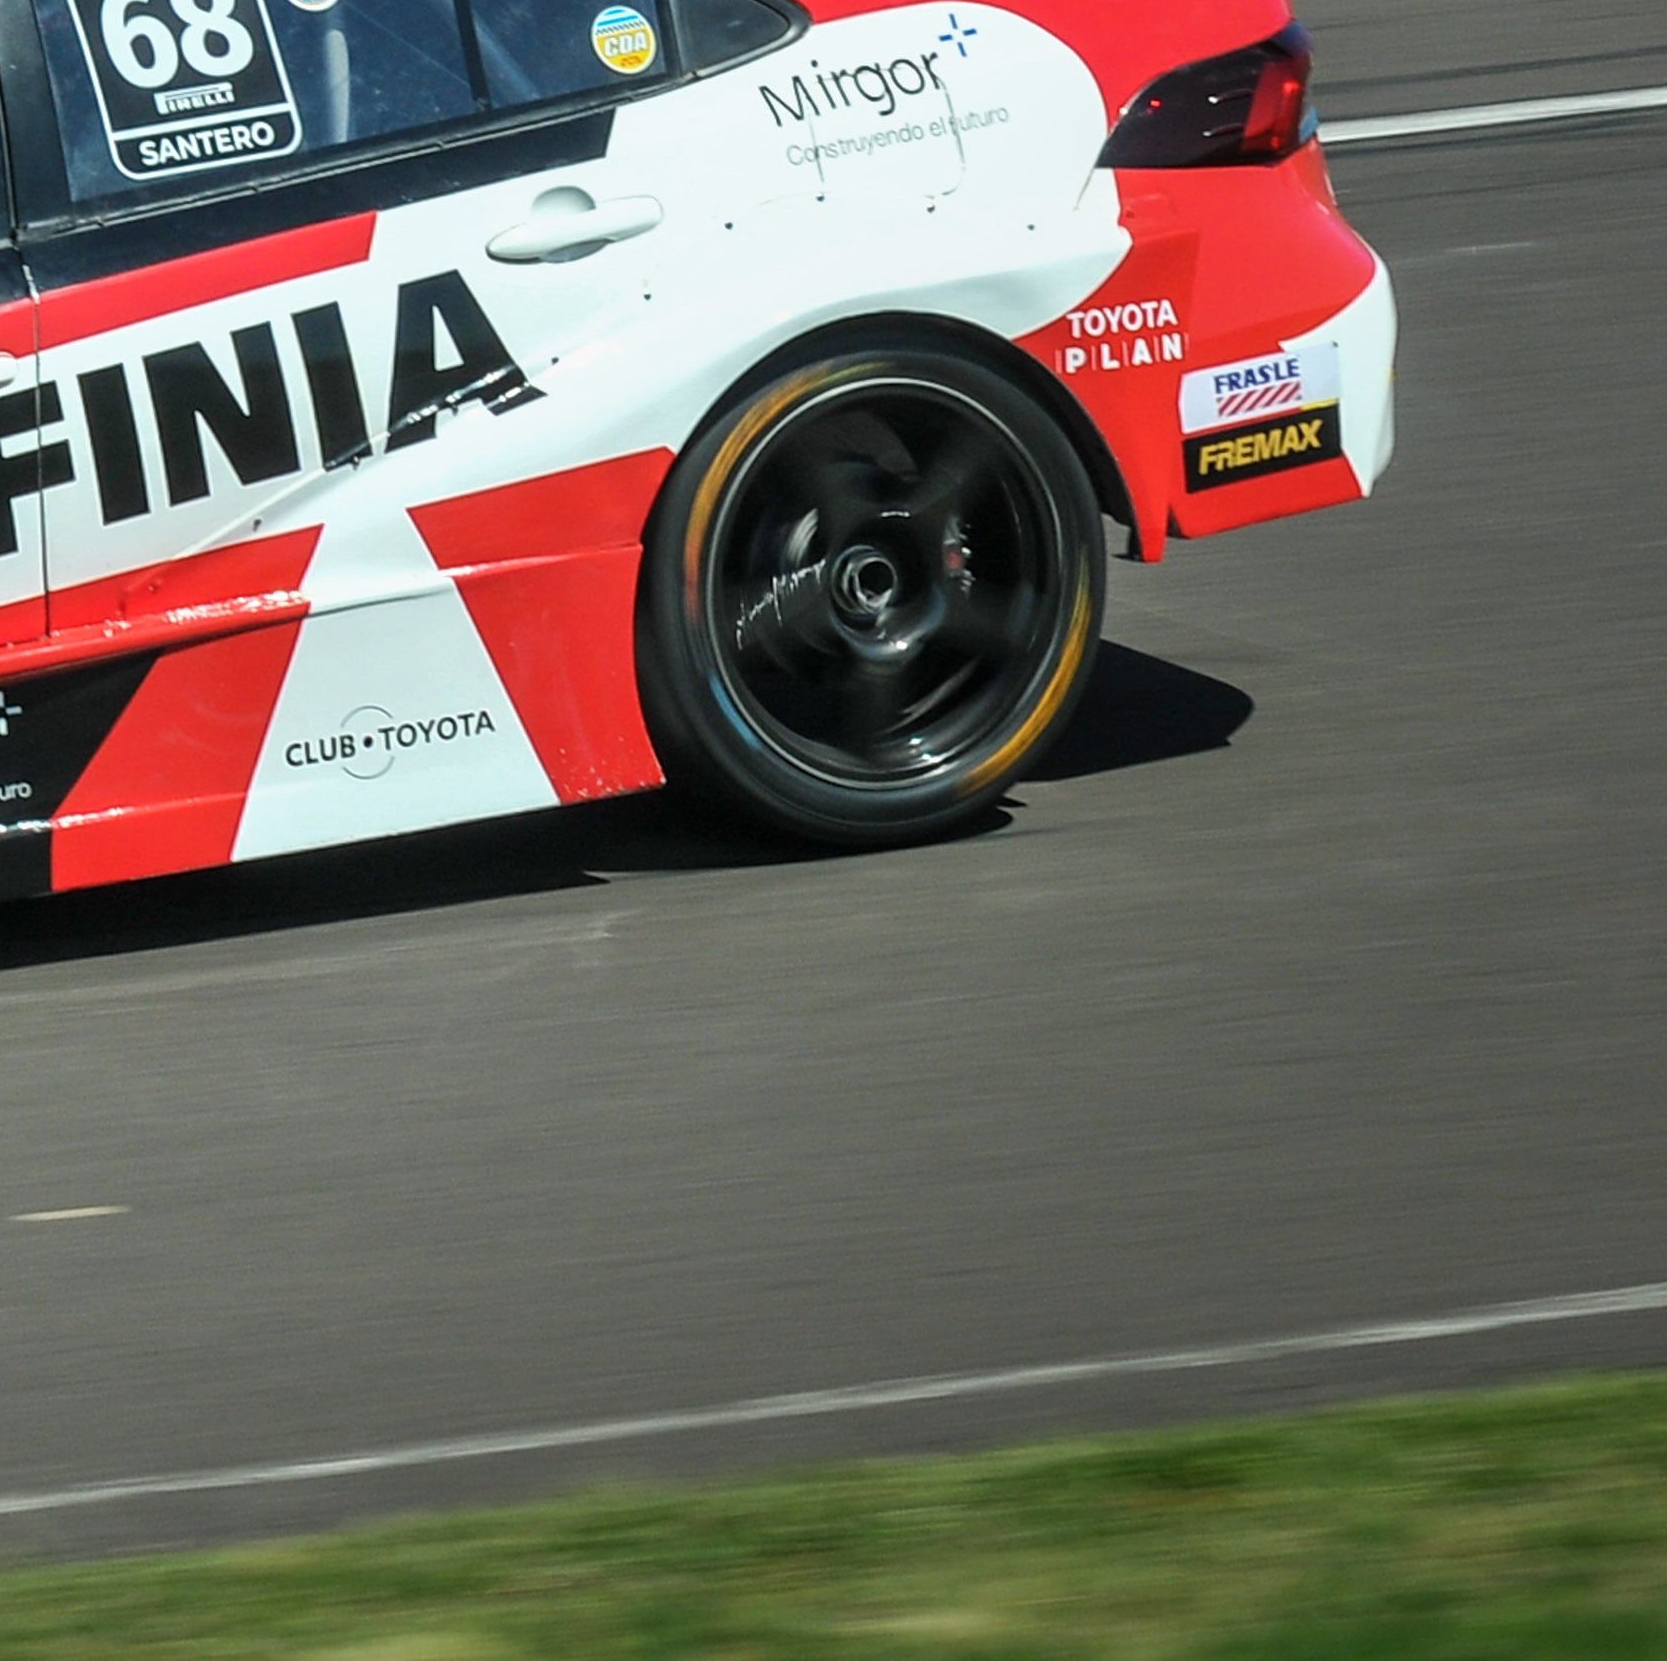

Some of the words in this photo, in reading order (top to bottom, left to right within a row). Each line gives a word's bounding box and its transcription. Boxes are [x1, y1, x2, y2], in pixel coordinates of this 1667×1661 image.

[154, 82, 235, 115] PIRELLI
[759, 52, 938, 126] Mirgor
[139, 121, 275, 166] SANTERO
[786, 122, 925, 166] Construyendo
[929, 116, 947, 138] el
[949, 106, 1009, 136] futuro
[1068, 298, 1178, 338] TOYOTA
[1198, 420, 1323, 475] FREMAX
[285, 734, 356, 767] CLUB
[378, 710, 496, 751] TOYOTA
